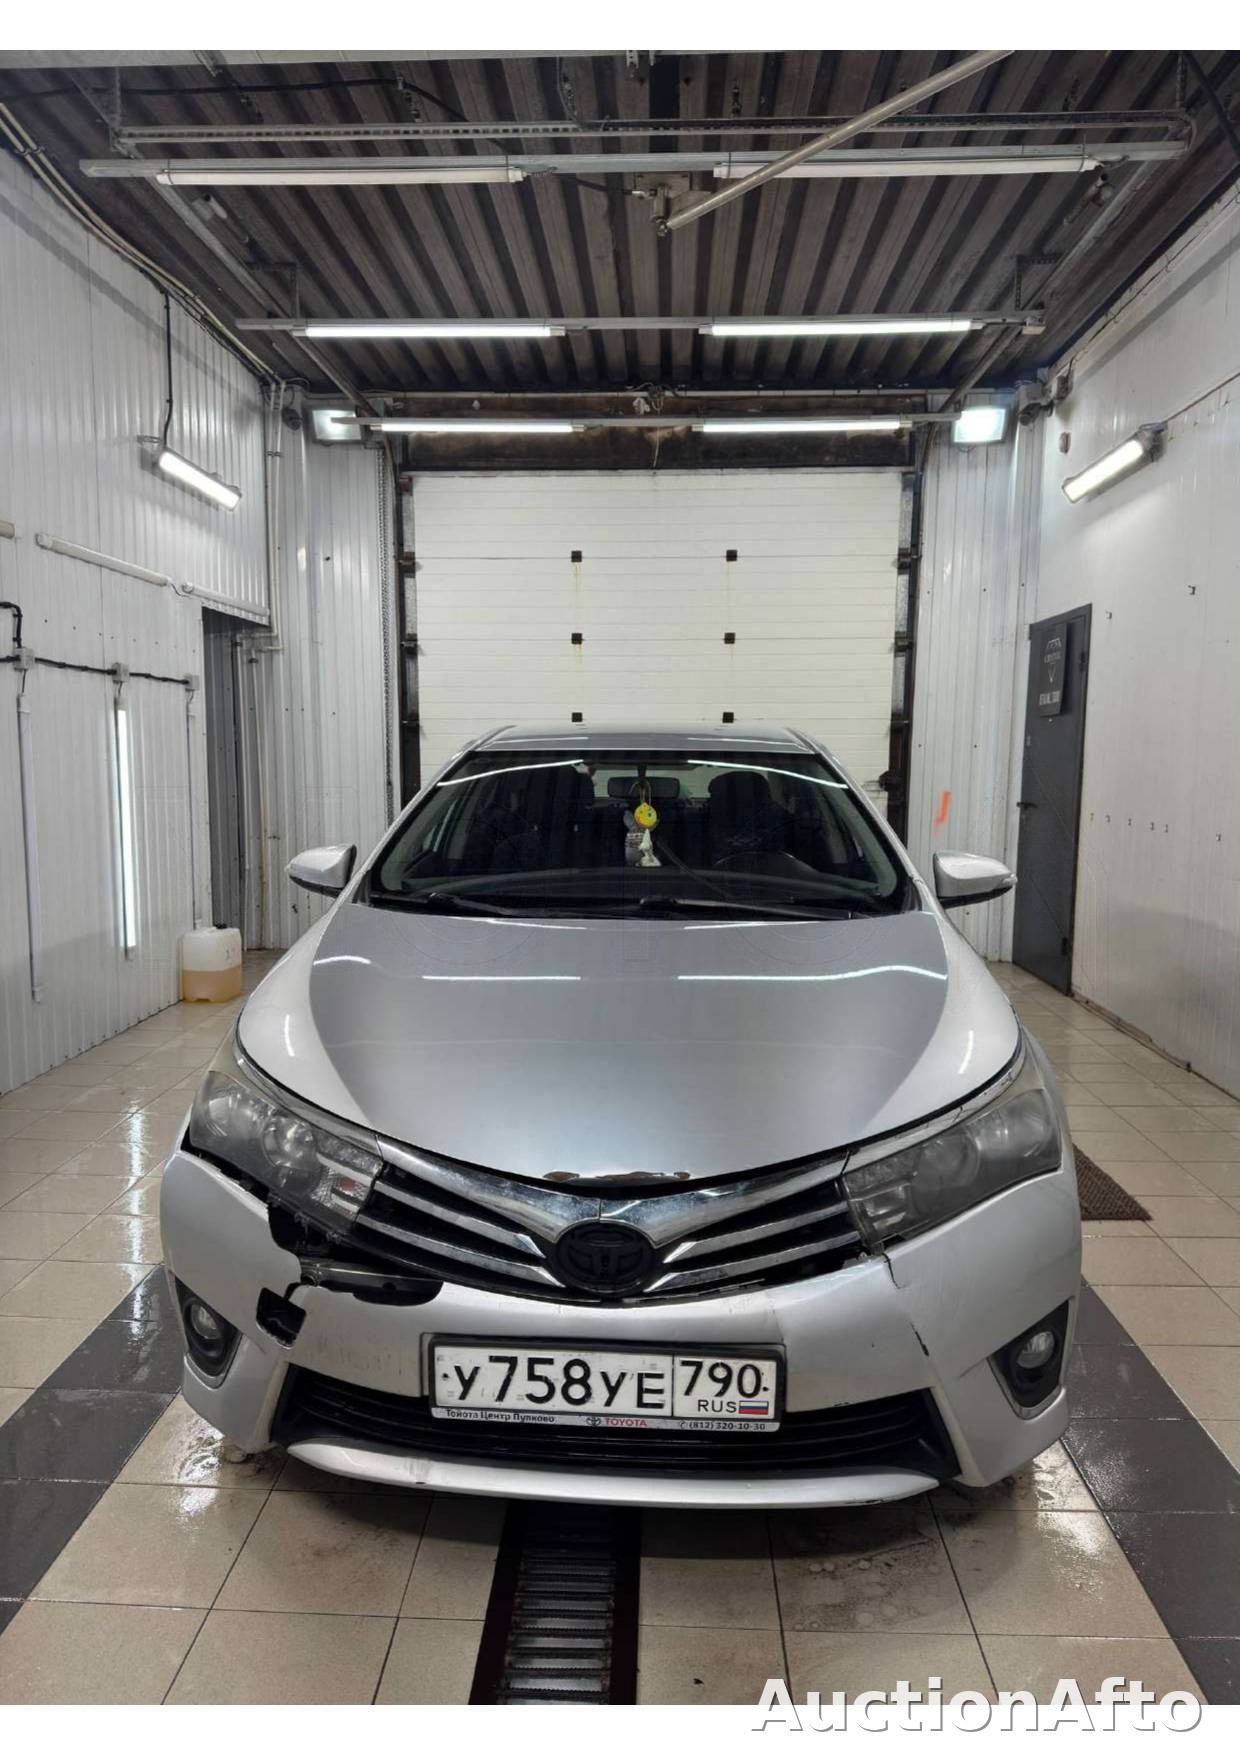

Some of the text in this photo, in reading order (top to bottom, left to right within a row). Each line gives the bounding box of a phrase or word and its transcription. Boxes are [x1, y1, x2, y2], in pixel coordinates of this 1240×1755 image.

[680, 1360, 763, 1399] 790
[697, 1399, 737, 1414] RUS
[446, 1409, 555, 1423] Тойота Центр Пулково
[604, 1418, 648, 1428] TOYOTA
[688, 1421, 714, 1430] (812)
